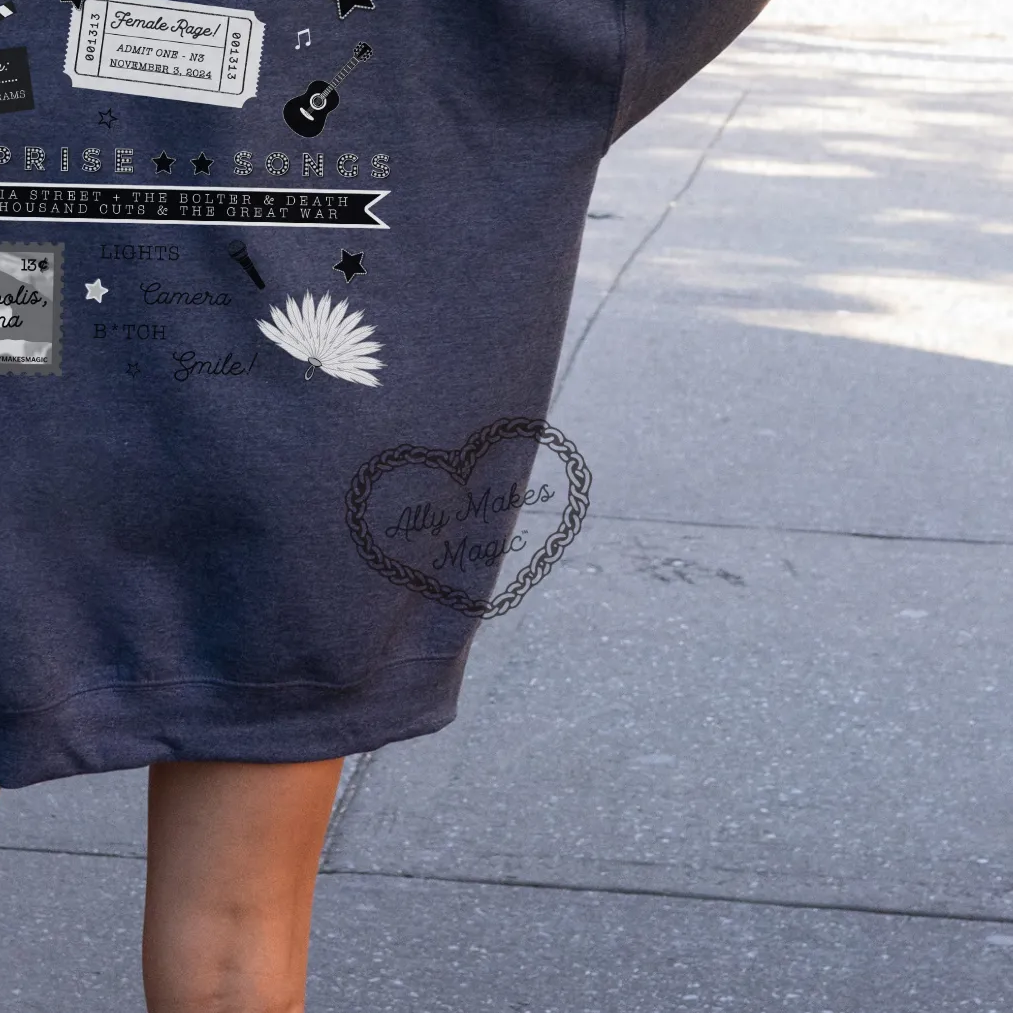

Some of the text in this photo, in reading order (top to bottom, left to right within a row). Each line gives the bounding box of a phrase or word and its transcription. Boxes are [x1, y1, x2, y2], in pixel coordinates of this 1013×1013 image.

[110, 10, 222, 40] Female Rage!
[85, 13, 100, 62] 001313
[116, 43, 154, 56] ADMIT
[155, 47, 179, 60] ONE
[189, 52, 205, 63] N3
[227, 32, 242, 81] 001313
[109, 58, 212, 80] NOVEMBER 3, 2024
[233, 150, 390, 179] SONGS
[29, 188, 102, 202] STREET
[132, 192, 168, 204] THE
[179, 193, 252, 206] BOLTER
[263, 194, 275, 206] &
[286, 195, 349, 207] DEATH
[99, 203, 145, 215] CUTS
[157, 205, 168, 217] &
[179, 205, 215, 217] THE
[226, 206, 289, 219] GREAT
[300, 208, 338, 220] WAR
[100, 244, 180, 262] LIGHTS
[20, 257, 49, 273] 13¢
[139, 282, 232, 306] Camera
[173, 351, 258, 382] Smile!
